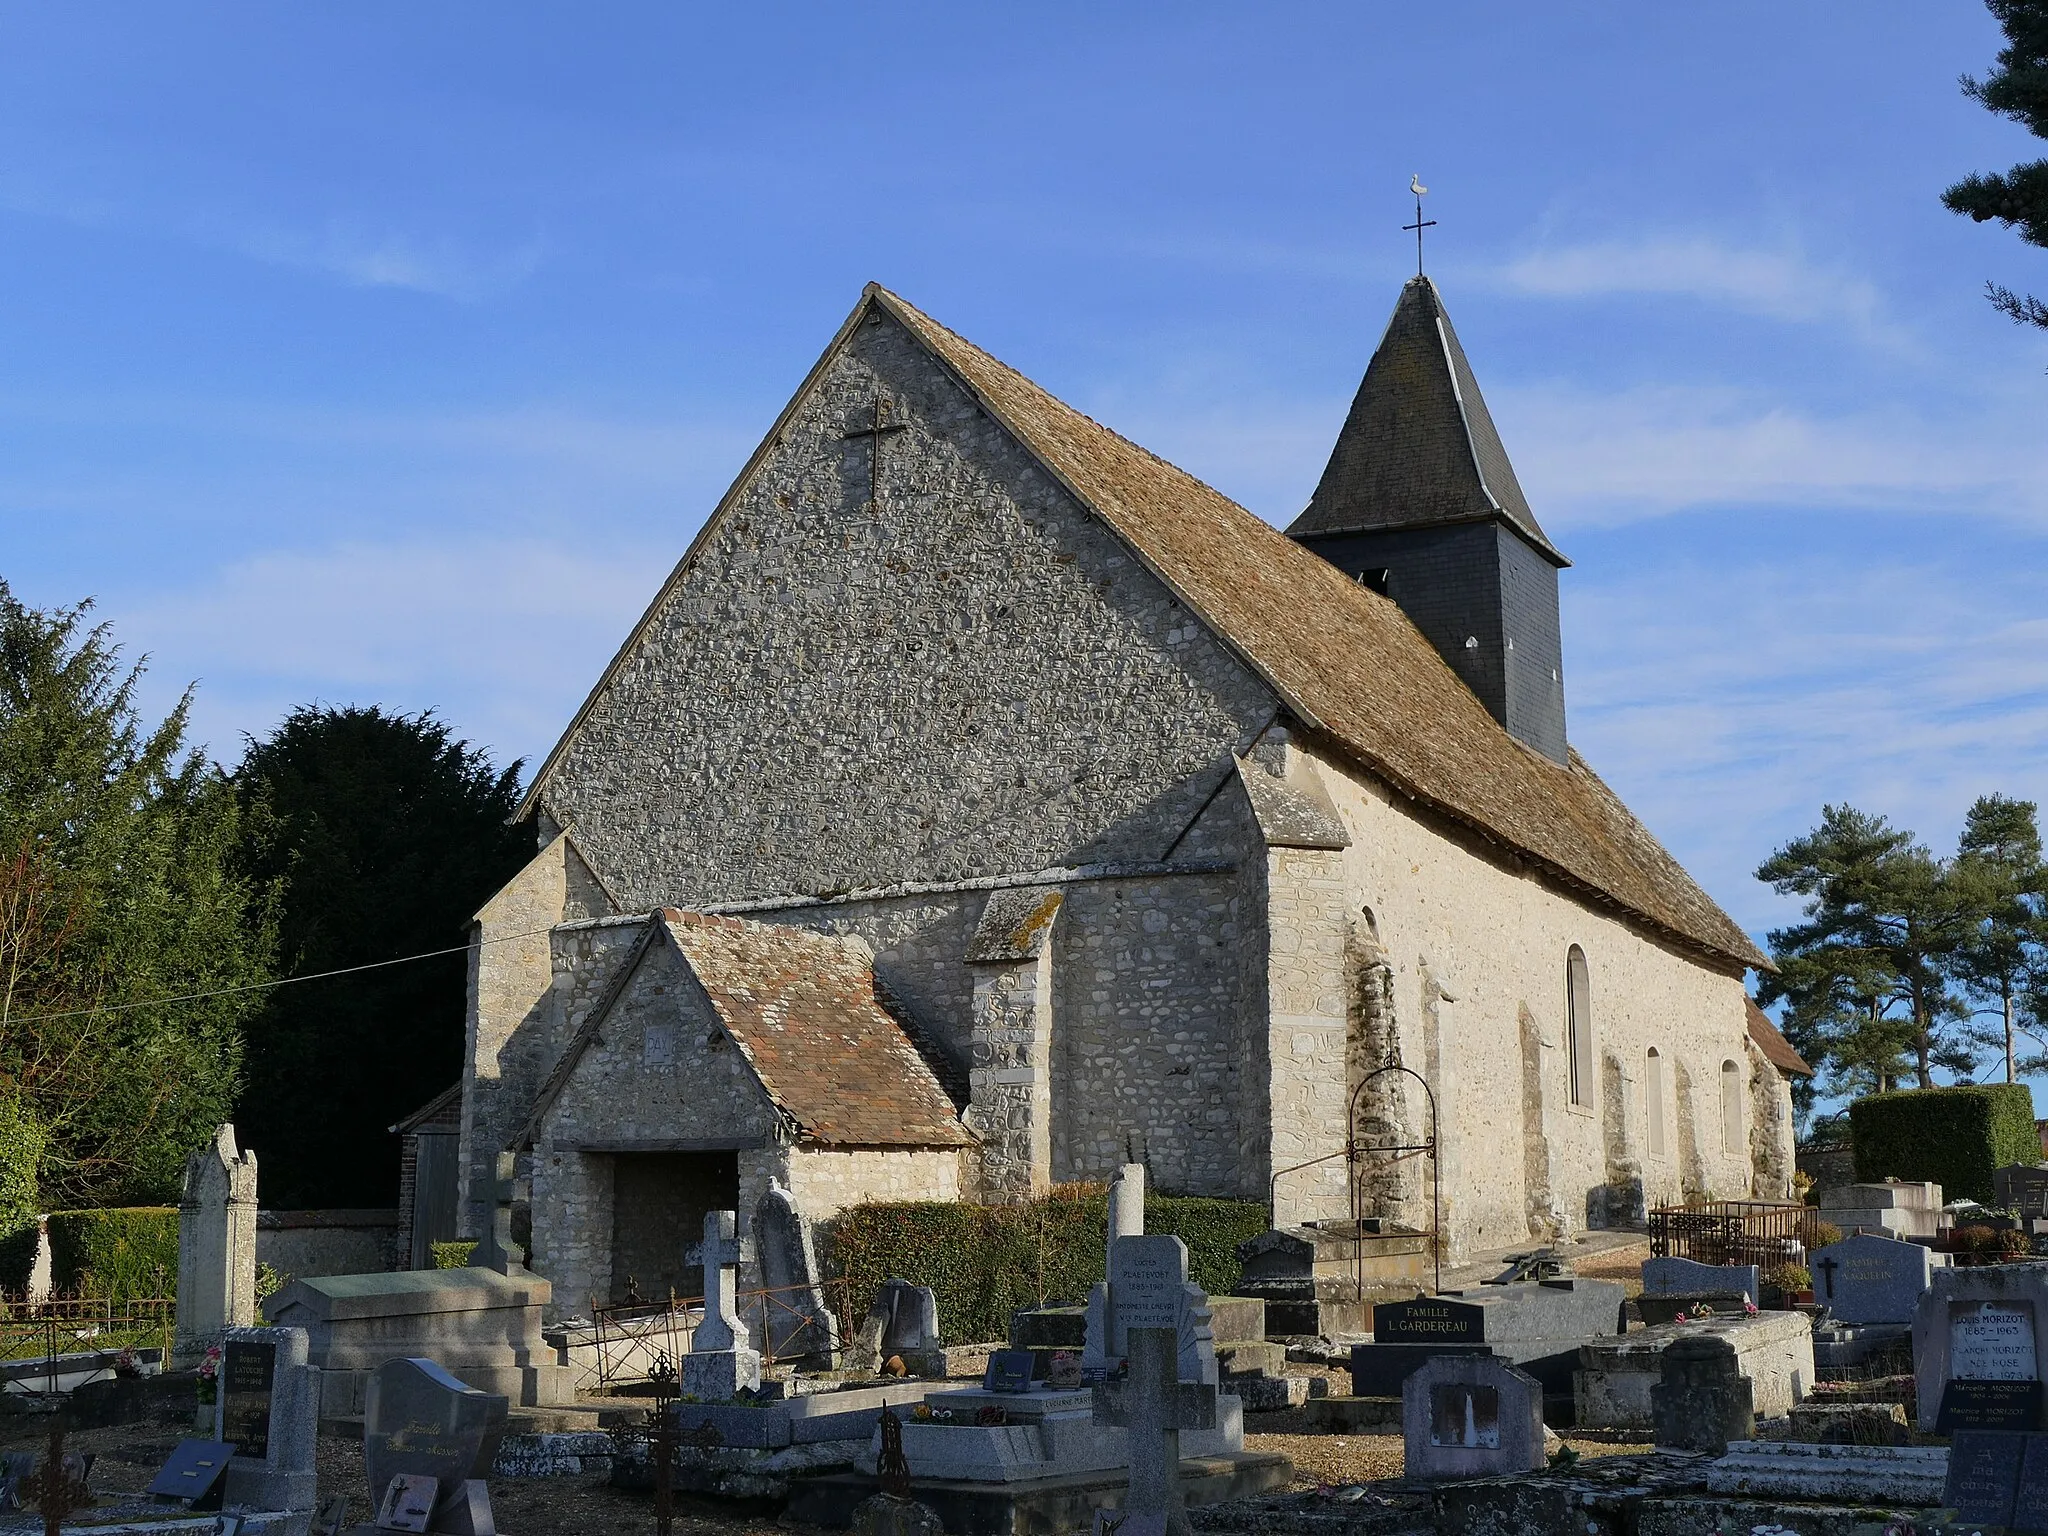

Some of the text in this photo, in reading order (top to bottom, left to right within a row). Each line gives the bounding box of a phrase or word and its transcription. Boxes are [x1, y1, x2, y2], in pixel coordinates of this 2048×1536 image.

[1407, 1307, 1449, 1318] FAMILLE
[1956, 1315, 2024, 1324] LOUIS MORIZOT
[1399, 1320, 1468, 1334] GARDEREAU
[1965, 1327, 1986, 1336] 1885
[1996, 1327, 2019, 1336] 1963
[1991, 1345, 2033, 1355] MORIZOT
[1990, 1384, 2032, 1393] MORIZOT
[1949, 1407, 2025, 1416] Maurice MORIZOT
